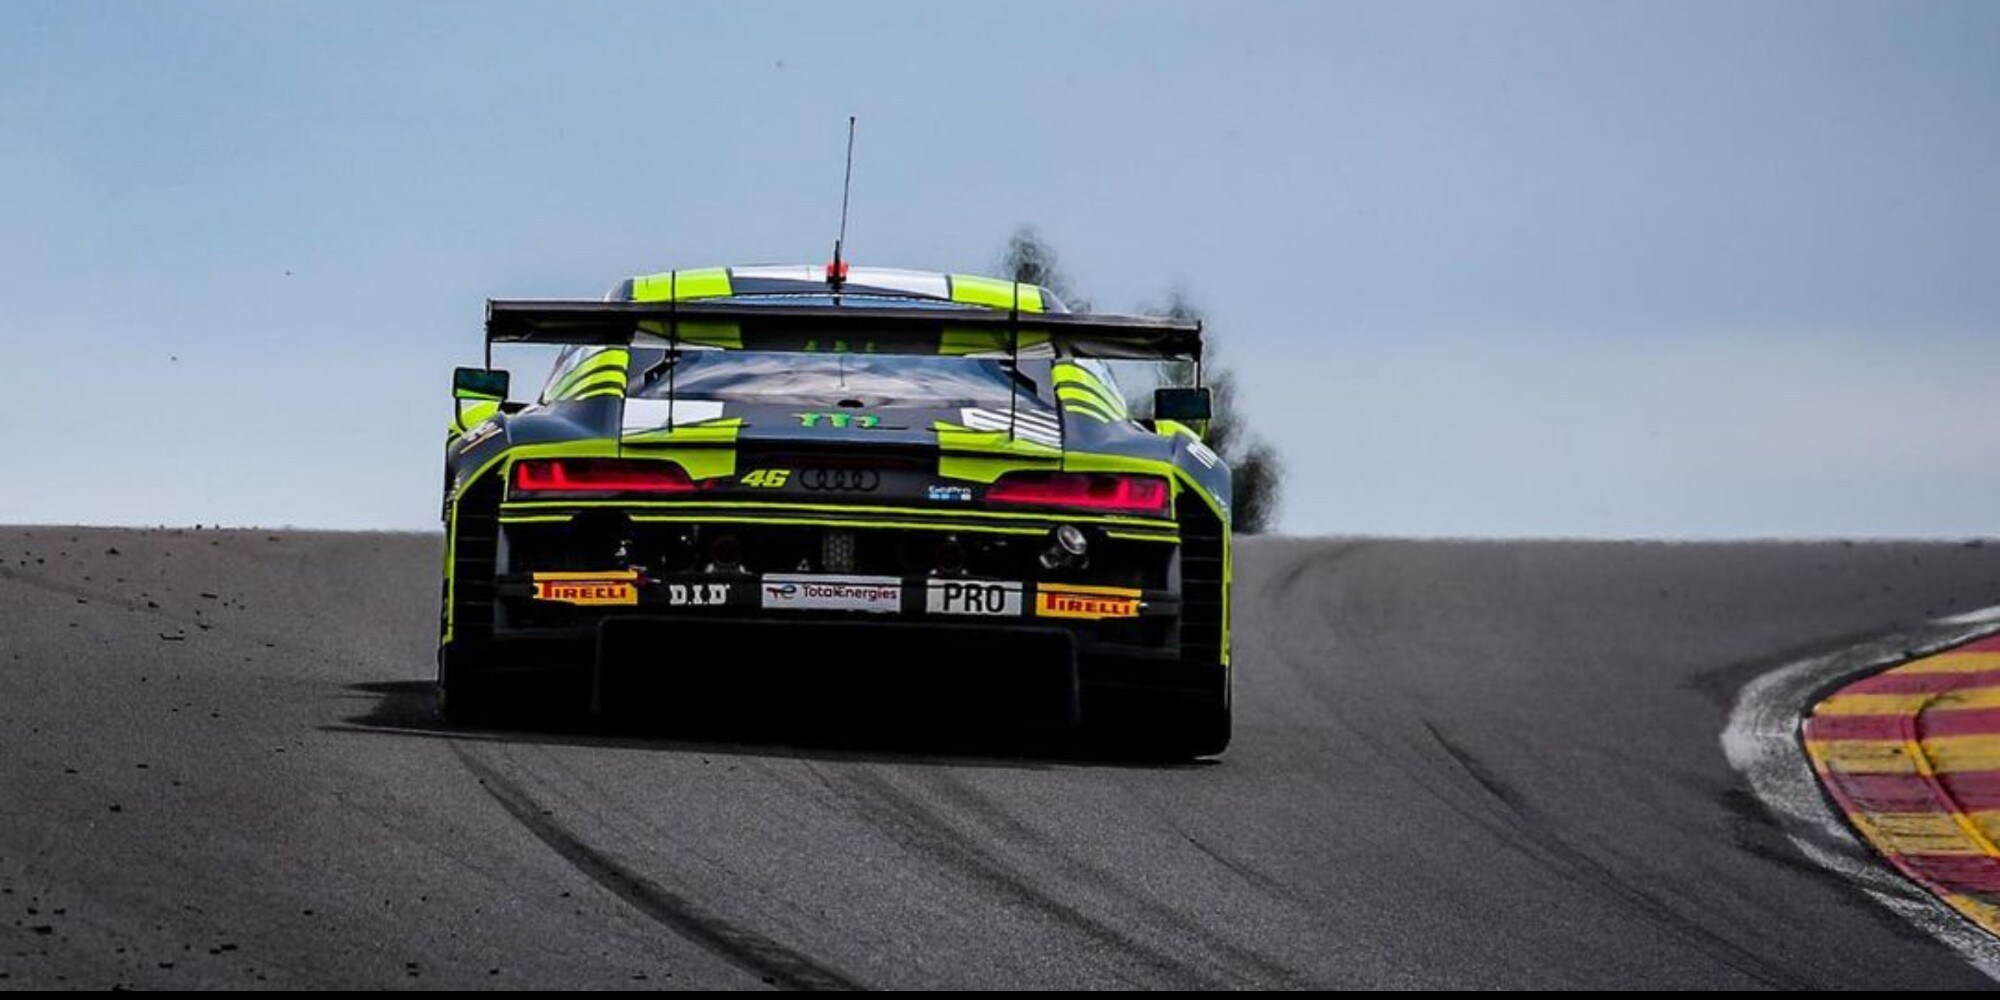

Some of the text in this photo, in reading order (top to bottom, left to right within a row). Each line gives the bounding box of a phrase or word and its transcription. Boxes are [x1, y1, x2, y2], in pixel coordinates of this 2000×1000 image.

[740, 469, 790, 488] 46
[542, 580, 627, 599] PIRELLI
[803, 585, 897, 602] TotalEnergies
[943, 582, 1005, 613] PRO
[1046, 593, 1131, 615] PIRELLI
